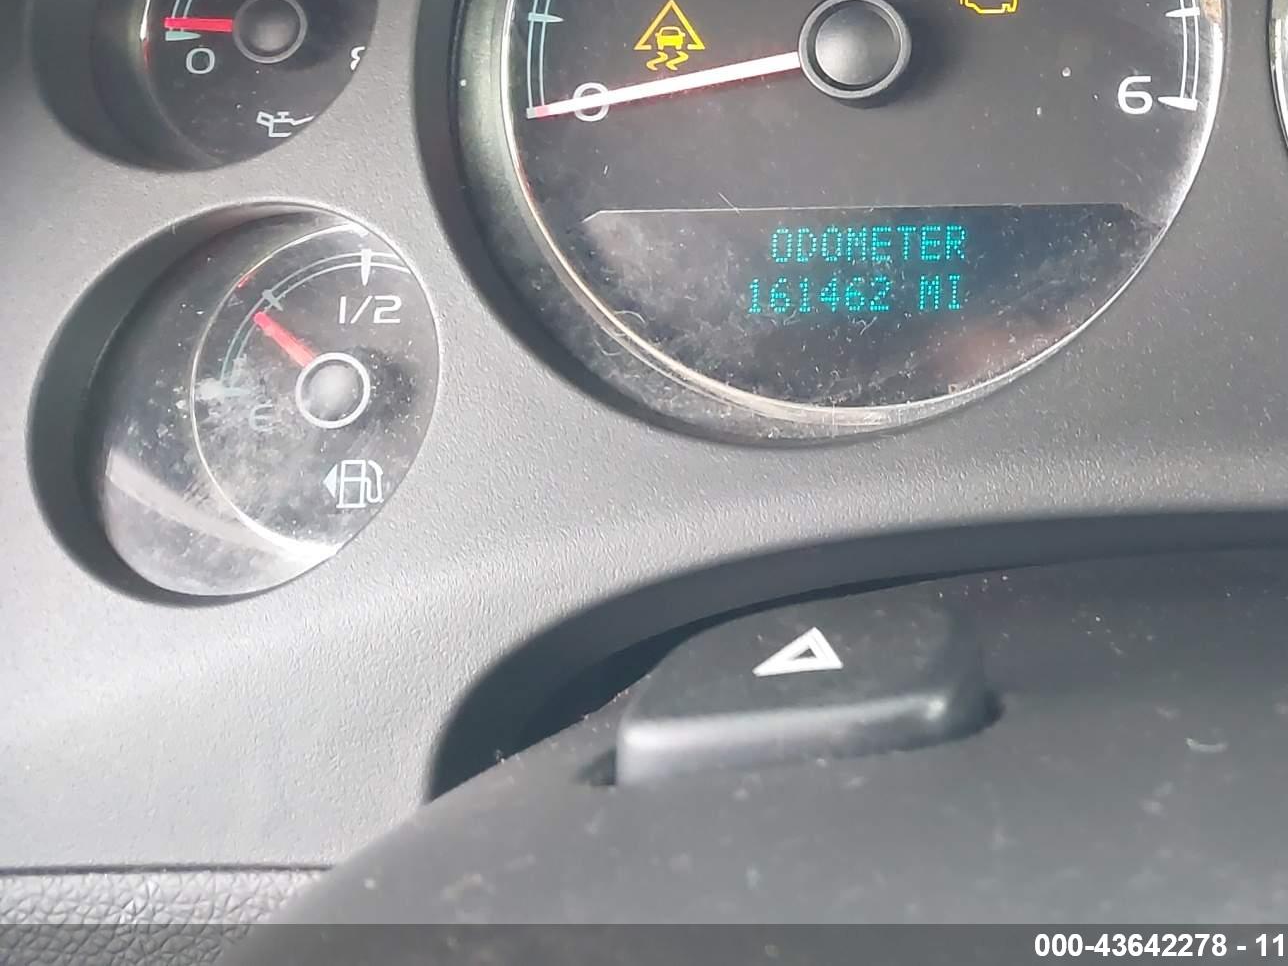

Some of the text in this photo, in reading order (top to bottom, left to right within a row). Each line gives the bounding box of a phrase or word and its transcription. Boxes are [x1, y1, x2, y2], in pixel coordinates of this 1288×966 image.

[185, 49, 215, 75] 0
[573, 82, 610, 122] 0
[1117, 76, 1152, 115] 6
[770, 225, 967, 263] ODOMETER
[337, 295, 402, 325] 1/2
[747, 275, 963, 315] 161462 MI
